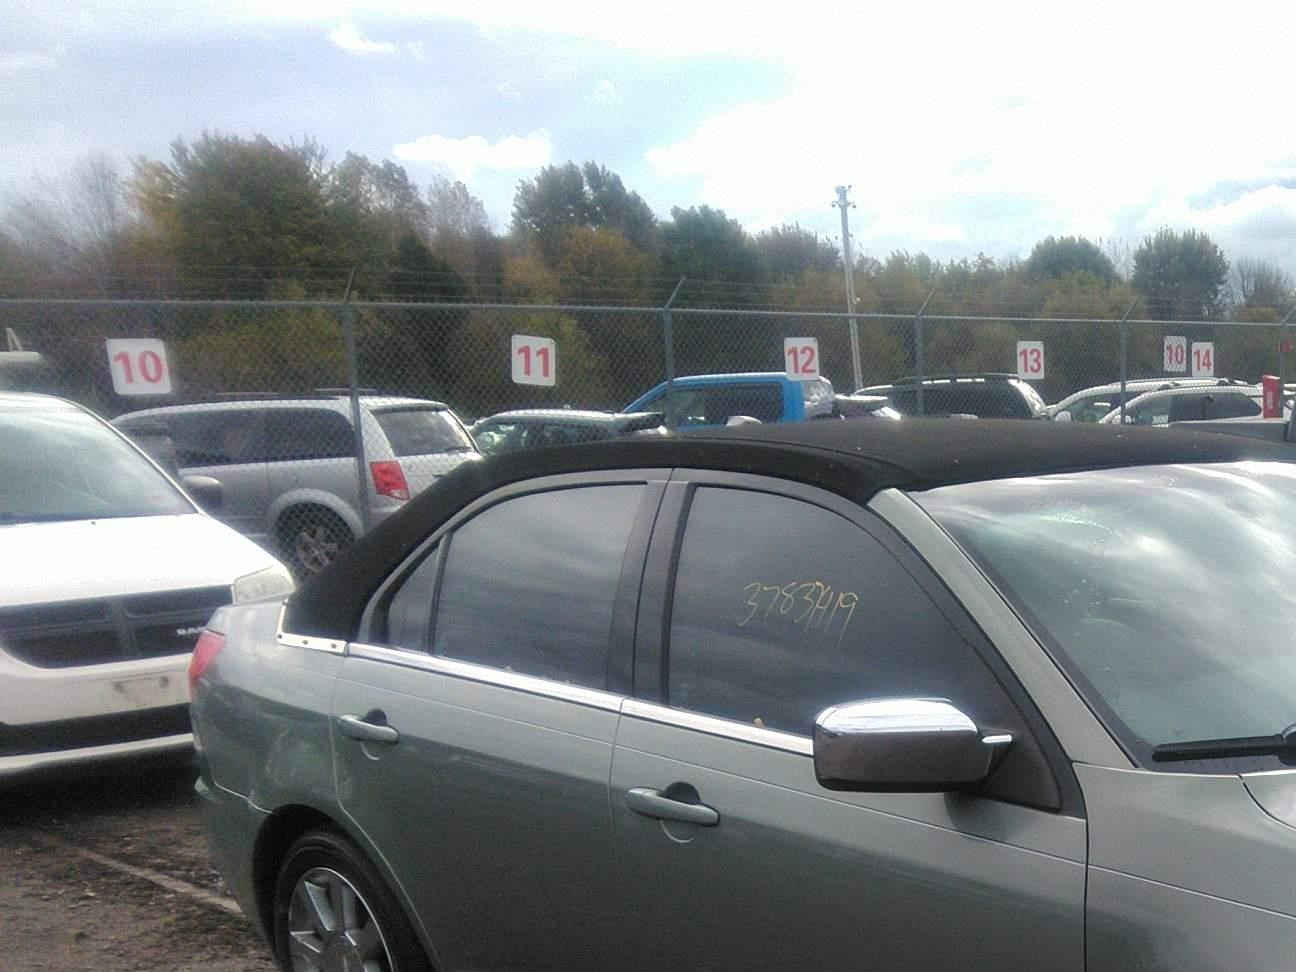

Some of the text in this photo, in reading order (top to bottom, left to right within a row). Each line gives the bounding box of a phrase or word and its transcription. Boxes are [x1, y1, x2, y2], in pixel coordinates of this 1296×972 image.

[113, 350, 163, 384] 10
[517, 345, 550, 378] 11
[788, 345, 817, 374] 12
[1019, 348, 1042, 373] 13
[1166, 343, 1184, 364] 10
[1193, 347, 1212, 371] 14
